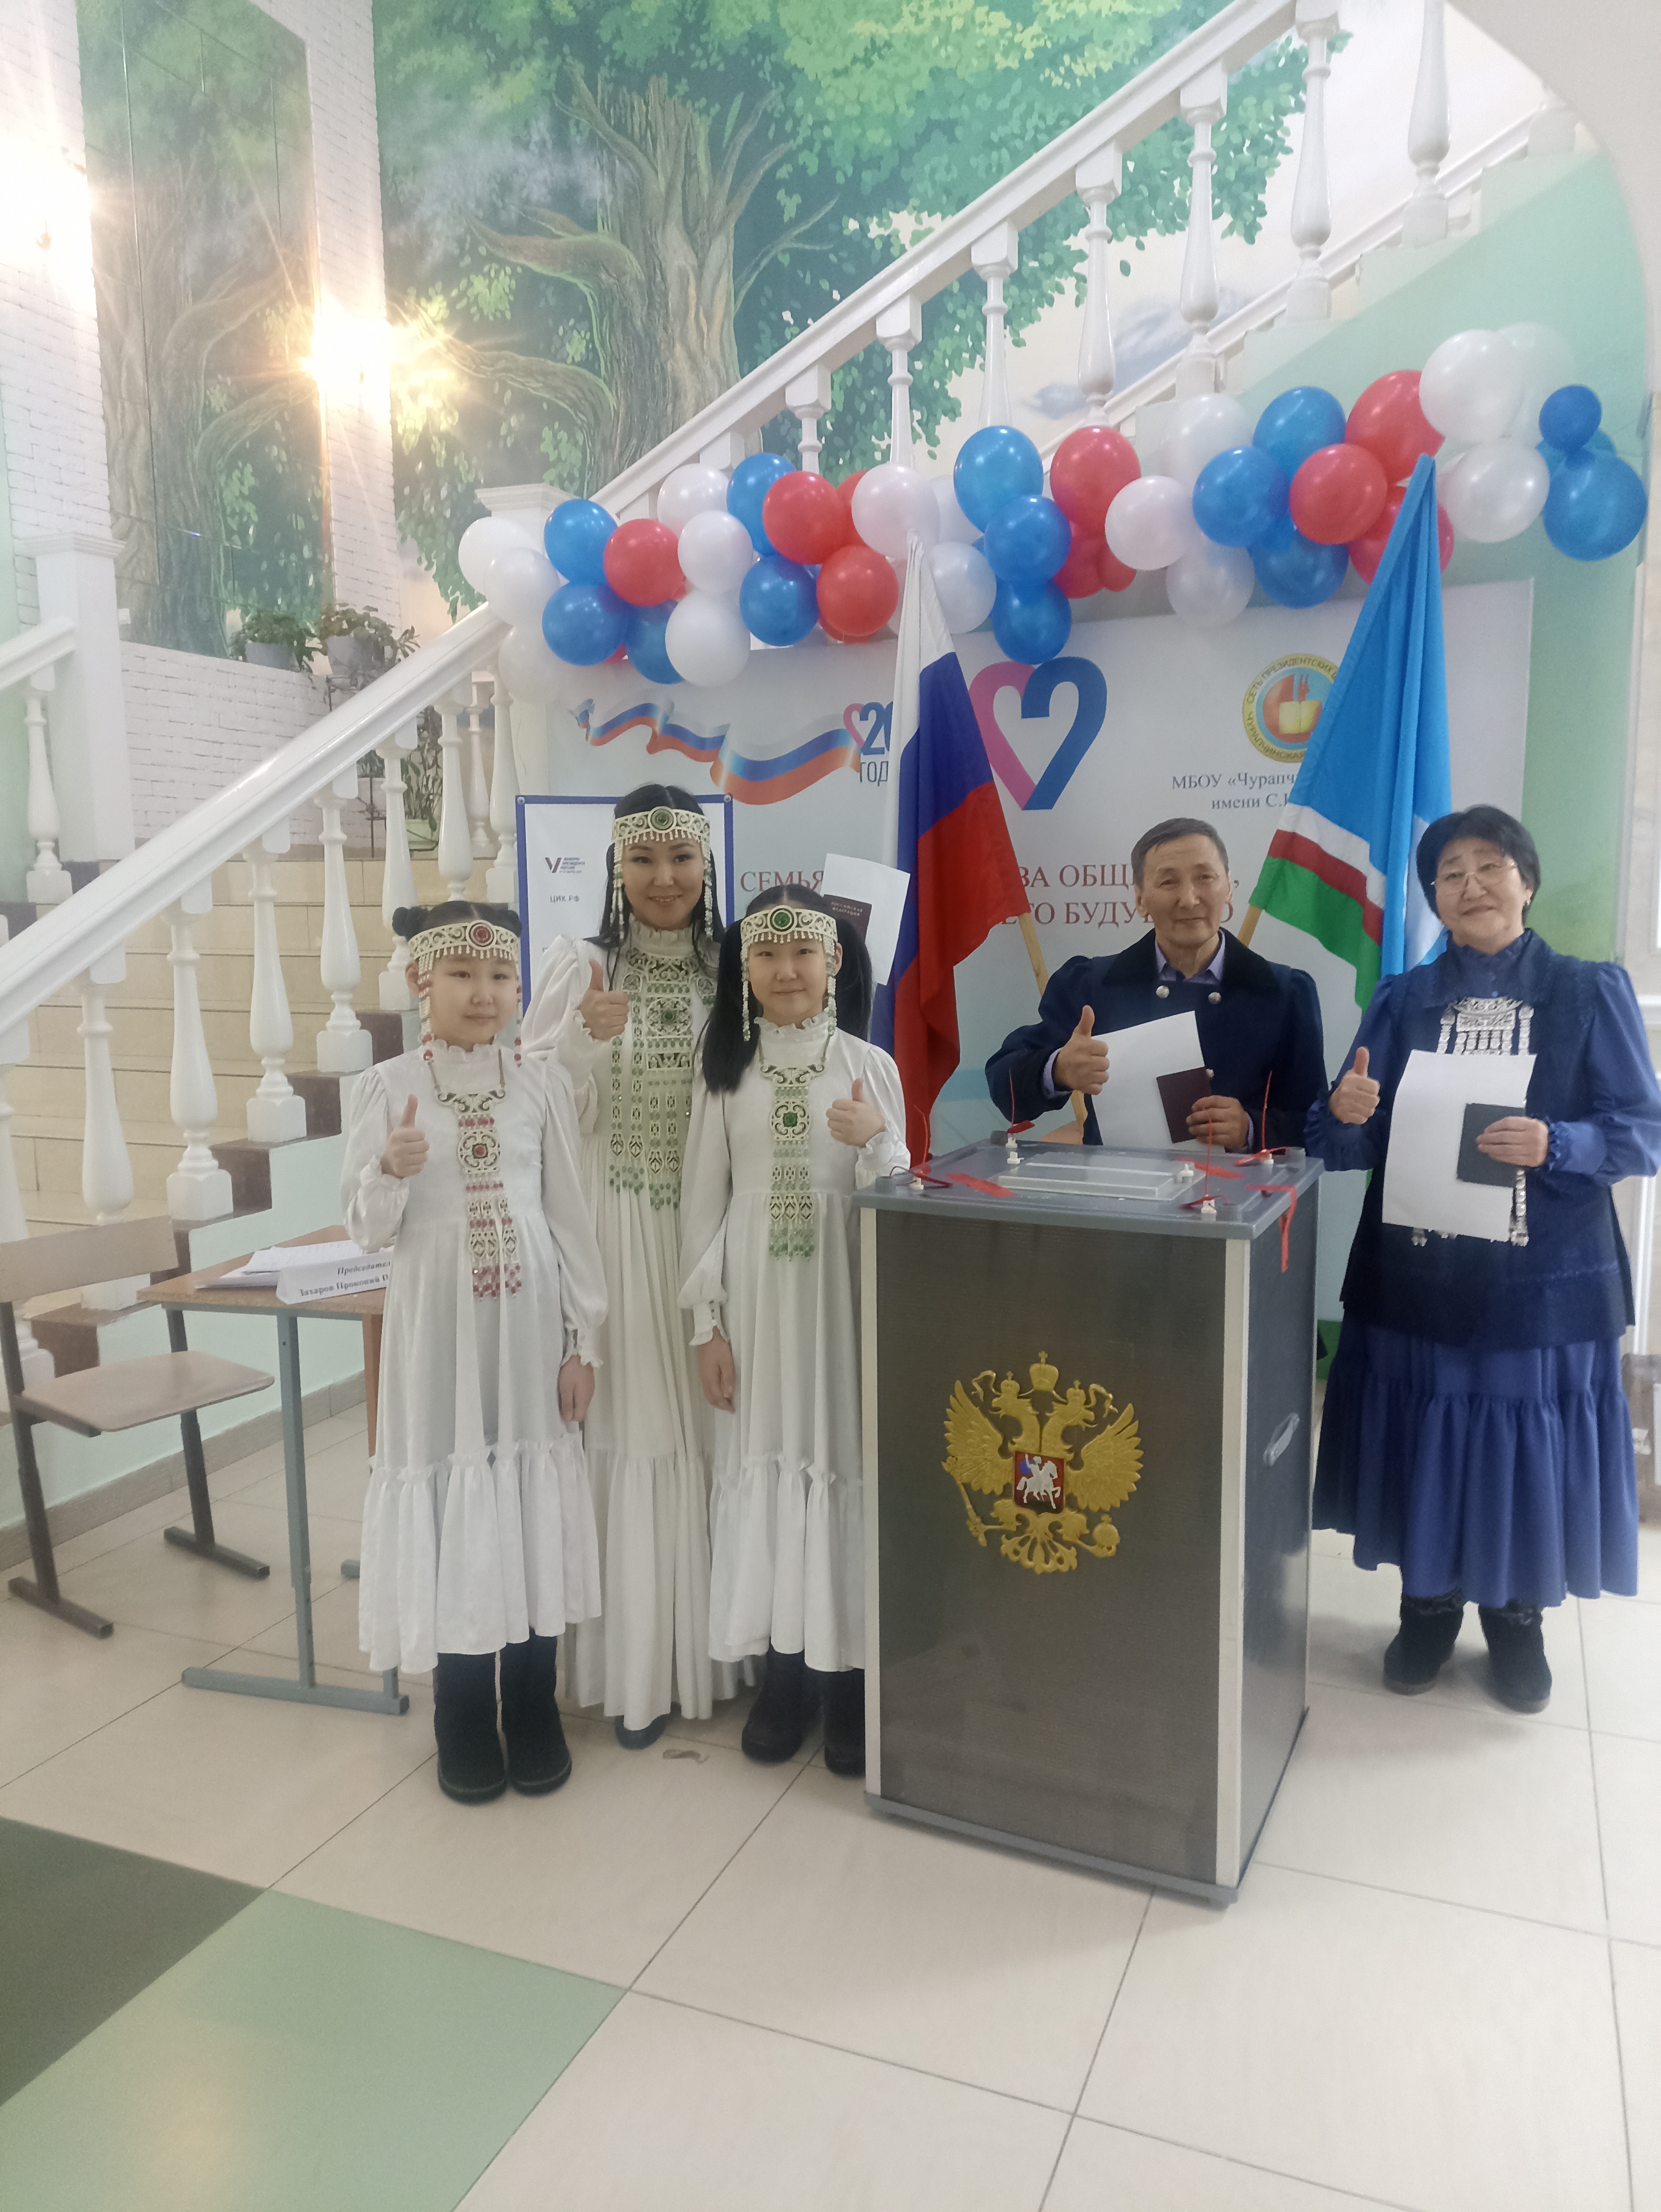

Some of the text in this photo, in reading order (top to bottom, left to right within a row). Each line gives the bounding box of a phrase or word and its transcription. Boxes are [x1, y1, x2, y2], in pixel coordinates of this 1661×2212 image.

[859, 761, 889, 787] ГОД
[1172, 772, 1298, 790] МБОУ «Чурапч
[1211, 797, 1261, 810] имени
[740, 870, 824, 893] СЕМЬЯ
